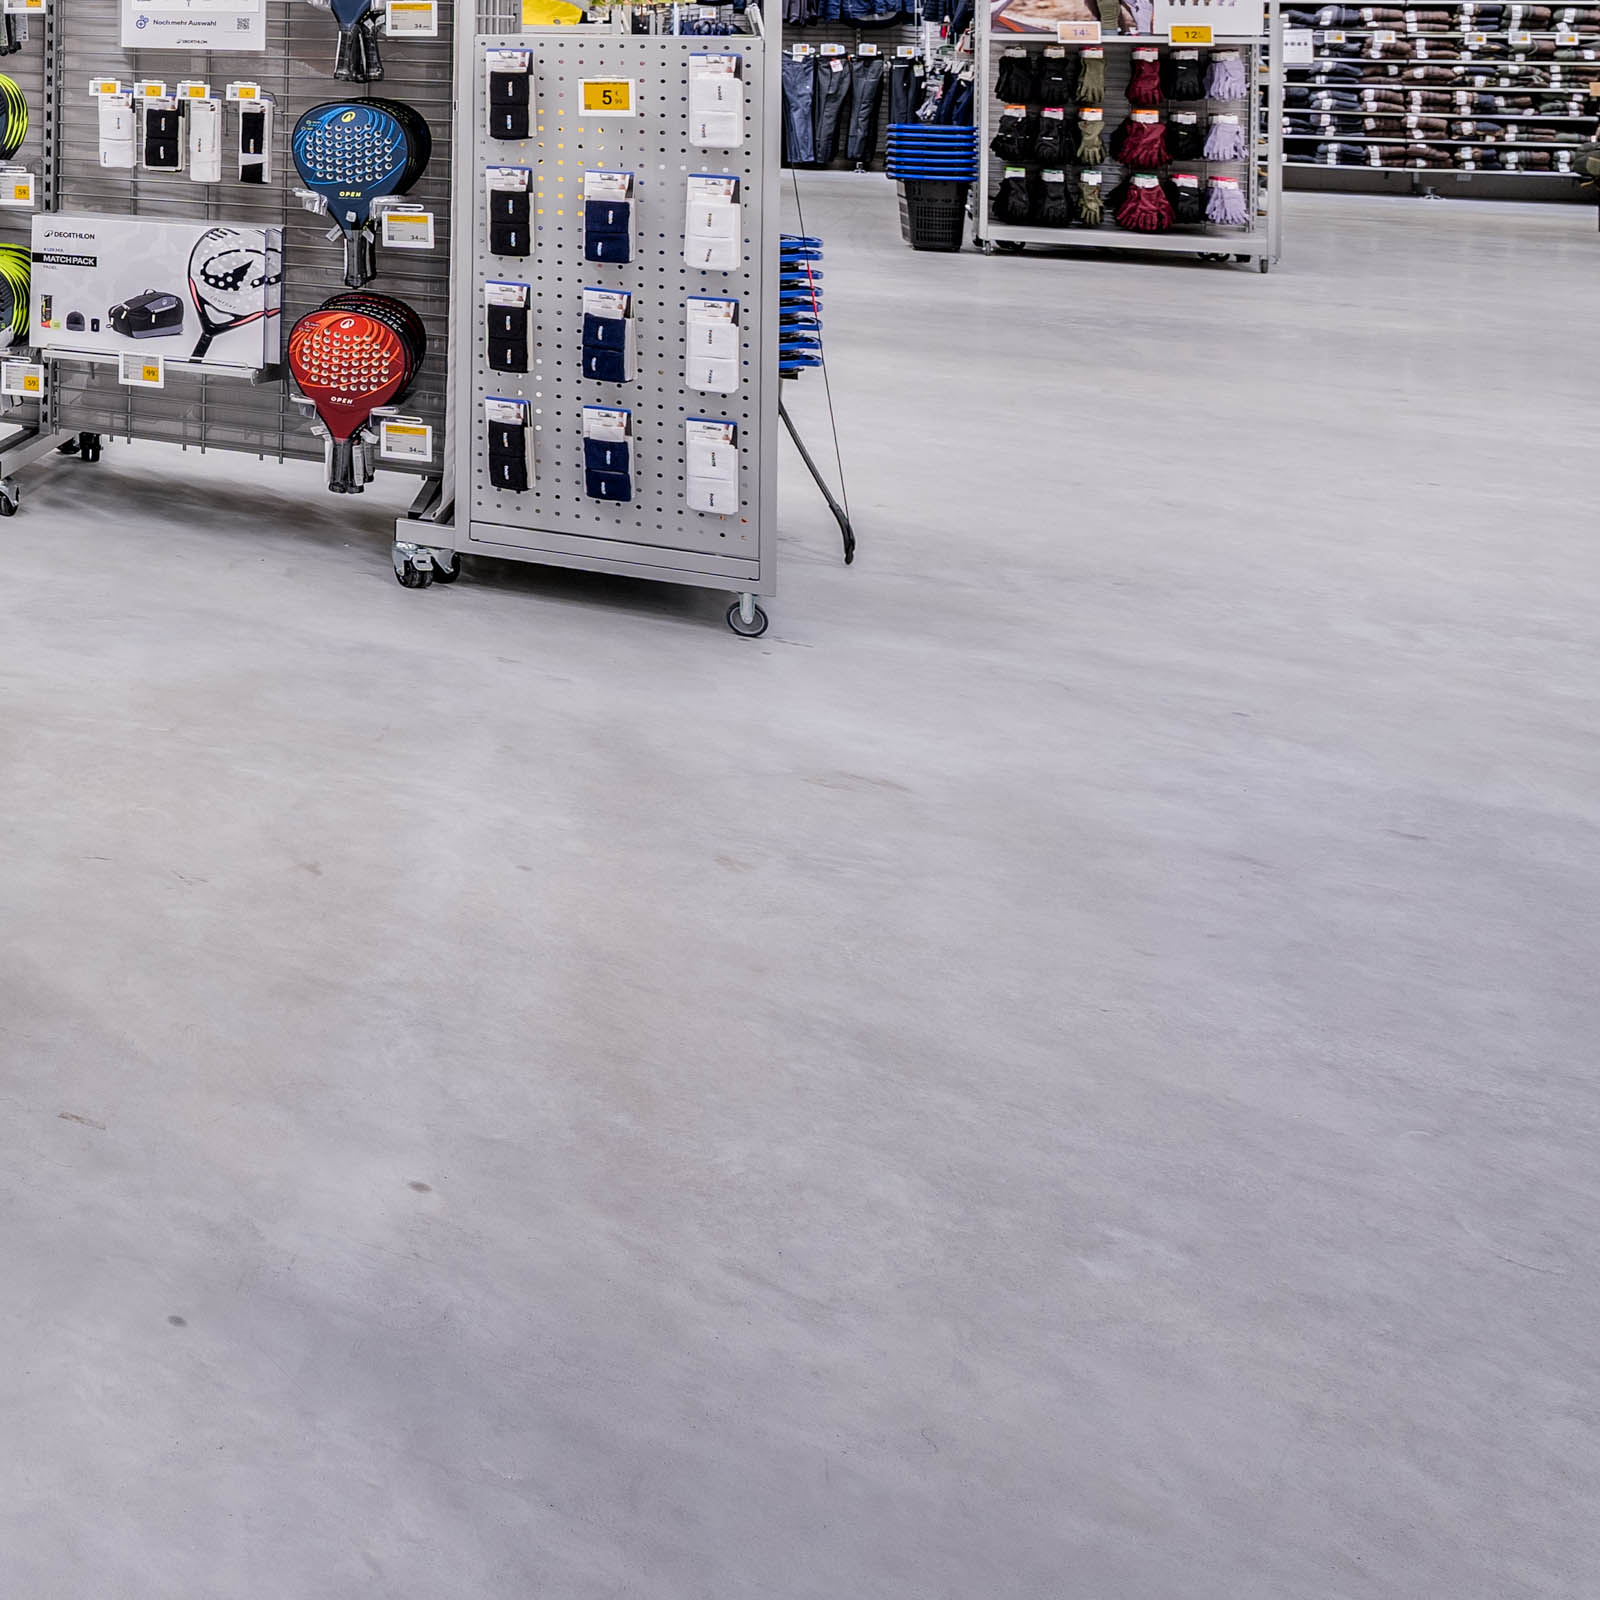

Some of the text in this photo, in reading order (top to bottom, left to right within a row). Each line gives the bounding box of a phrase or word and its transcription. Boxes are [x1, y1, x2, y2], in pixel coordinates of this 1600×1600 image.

[338, 190, 362, 198] OPEN
[54, 232, 96, 240] DECATHLON
[43, 254, 95, 266] MATCH PACK
[330, 395, 354, 405] OPEN
